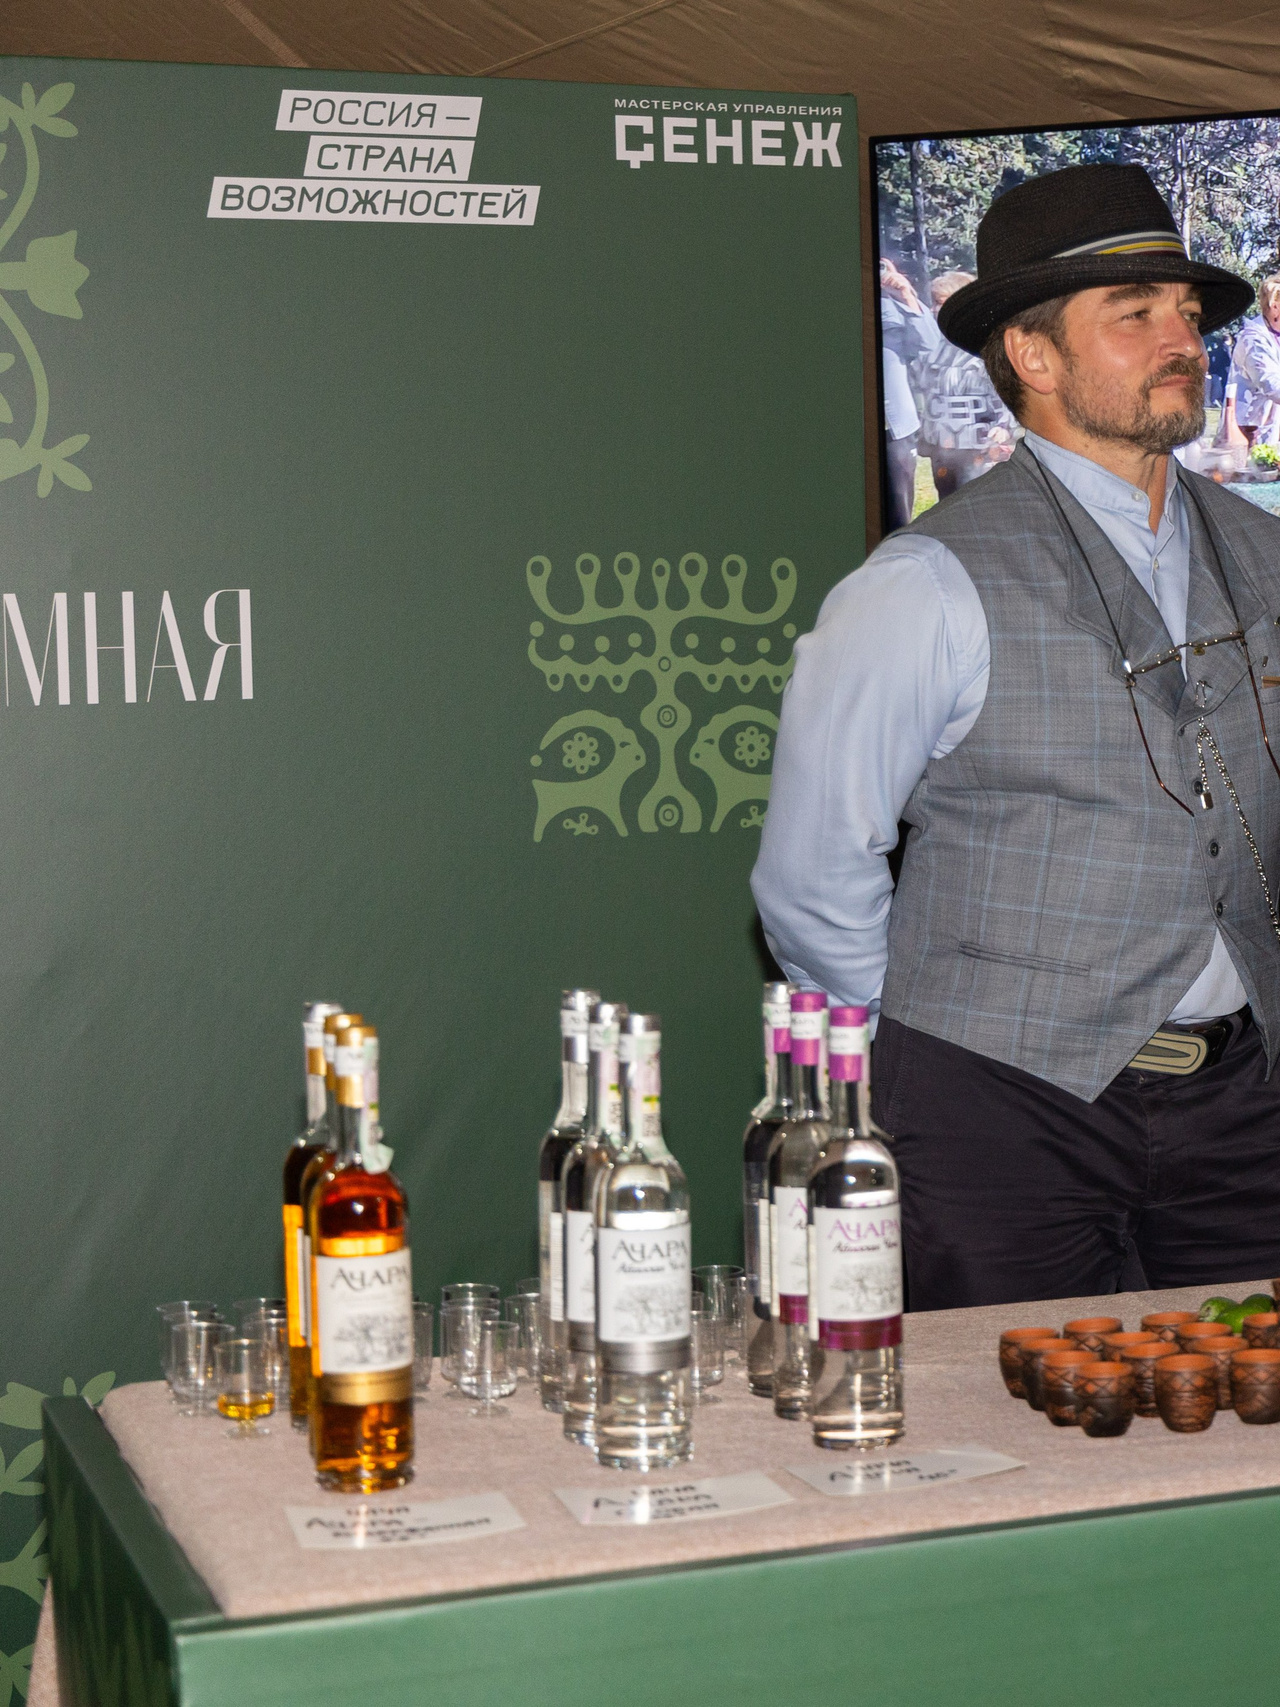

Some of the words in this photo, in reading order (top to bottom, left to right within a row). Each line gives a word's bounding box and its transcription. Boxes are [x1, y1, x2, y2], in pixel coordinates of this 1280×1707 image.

[289, 97, 436, 128] РОССИЯ
[614, 98, 728, 112] МАСТЕРСКАЯ
[733, 103, 842, 116] УПРАВЛЕНИЯ
[317, 144, 456, 174] СТРАНА
[220, 184, 527, 219] ВОЗМОЖНОСТЕЙ
